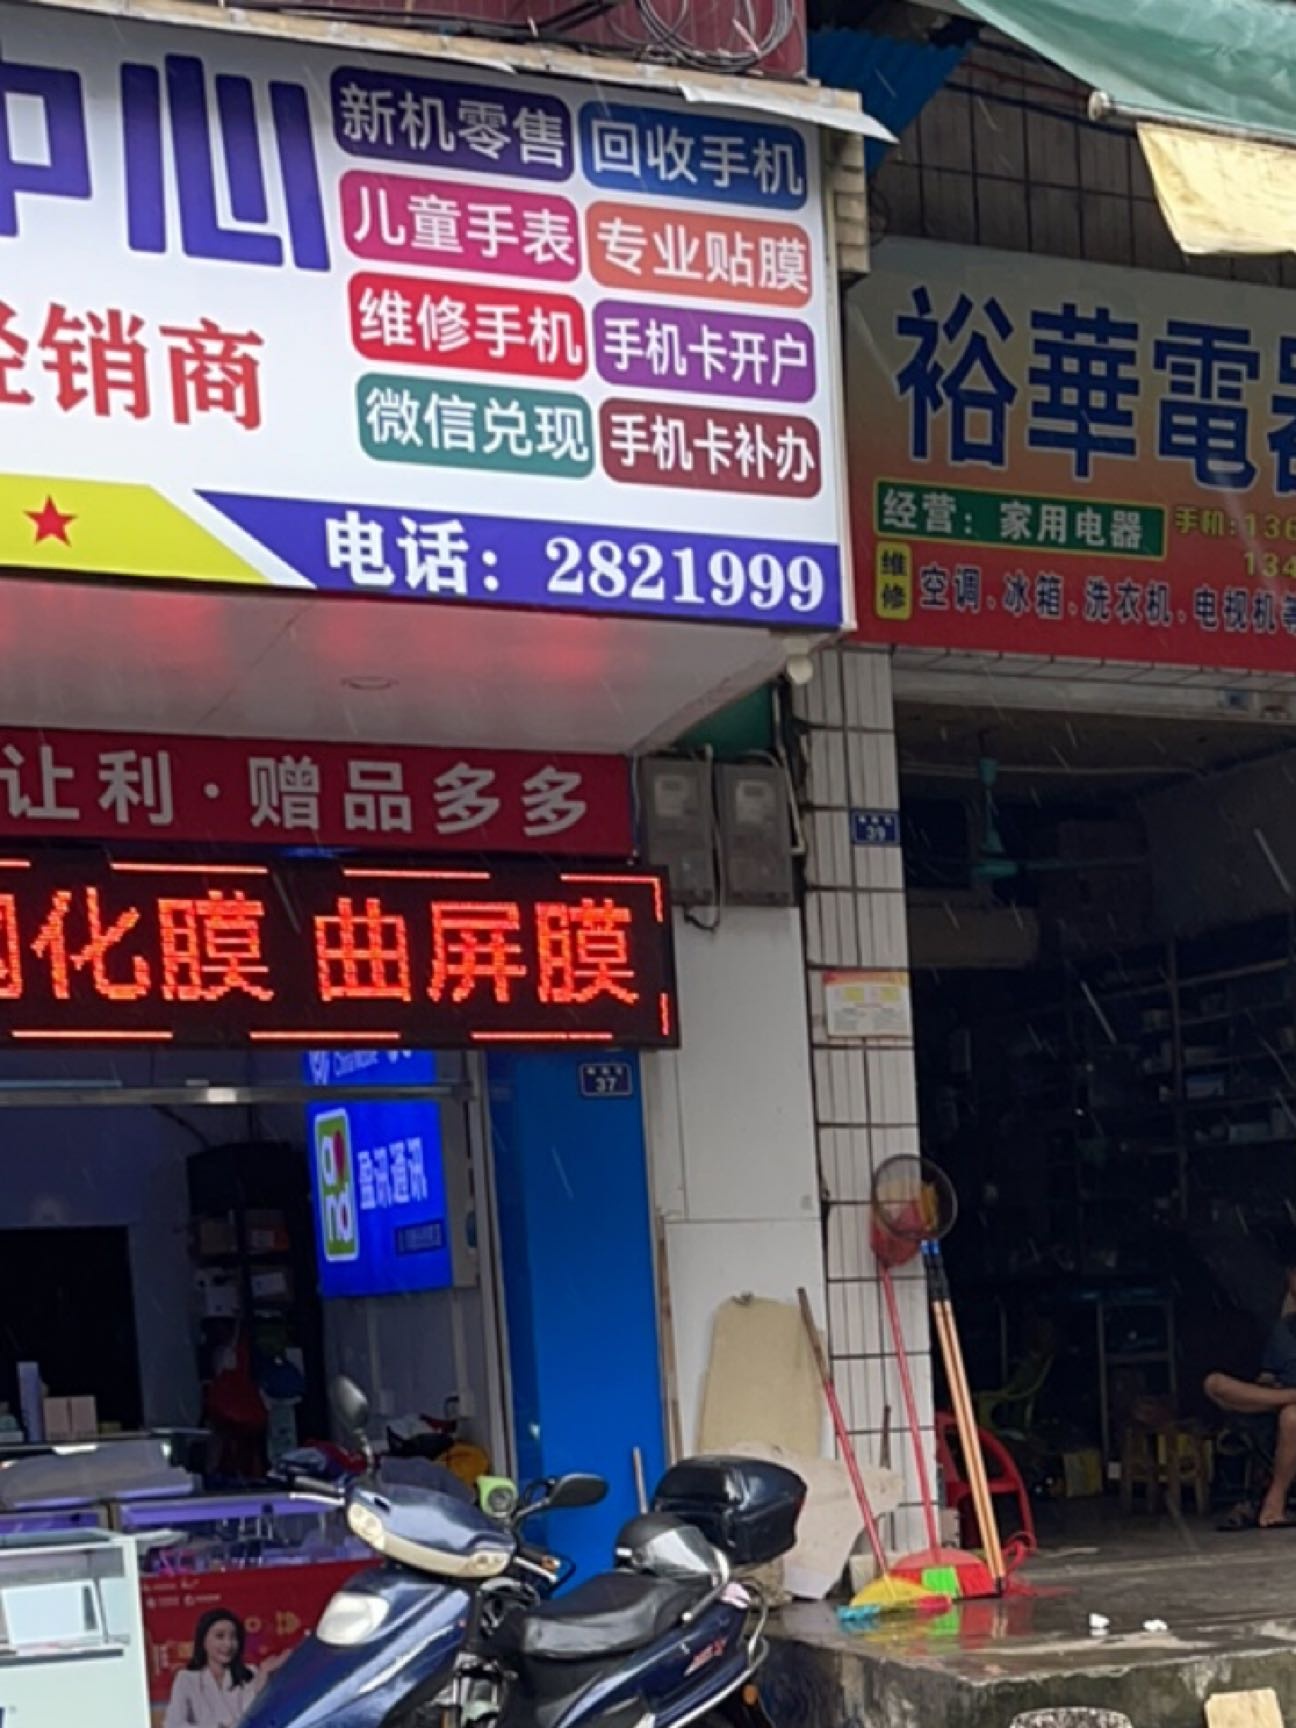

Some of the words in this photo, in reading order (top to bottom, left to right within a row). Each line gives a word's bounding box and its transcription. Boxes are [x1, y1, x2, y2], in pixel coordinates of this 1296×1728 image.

[339, 84, 567, 168] 新机零售
[590, 121, 804, 196] 回收手机
[353, 188, 576, 265] 儿童手表
[596, 219, 808, 293] 专业贴膜
[358, 289, 583, 365] 维修手机
[604, 319, 807, 386] 手机卡开户
[365, 390, 590, 462] 微信兑现
[610, 416, 815, 484] 手机卡补办
[0, 886, 274, 1001] 化膜
[314, 897, 639, 1005] 曲屏膜
